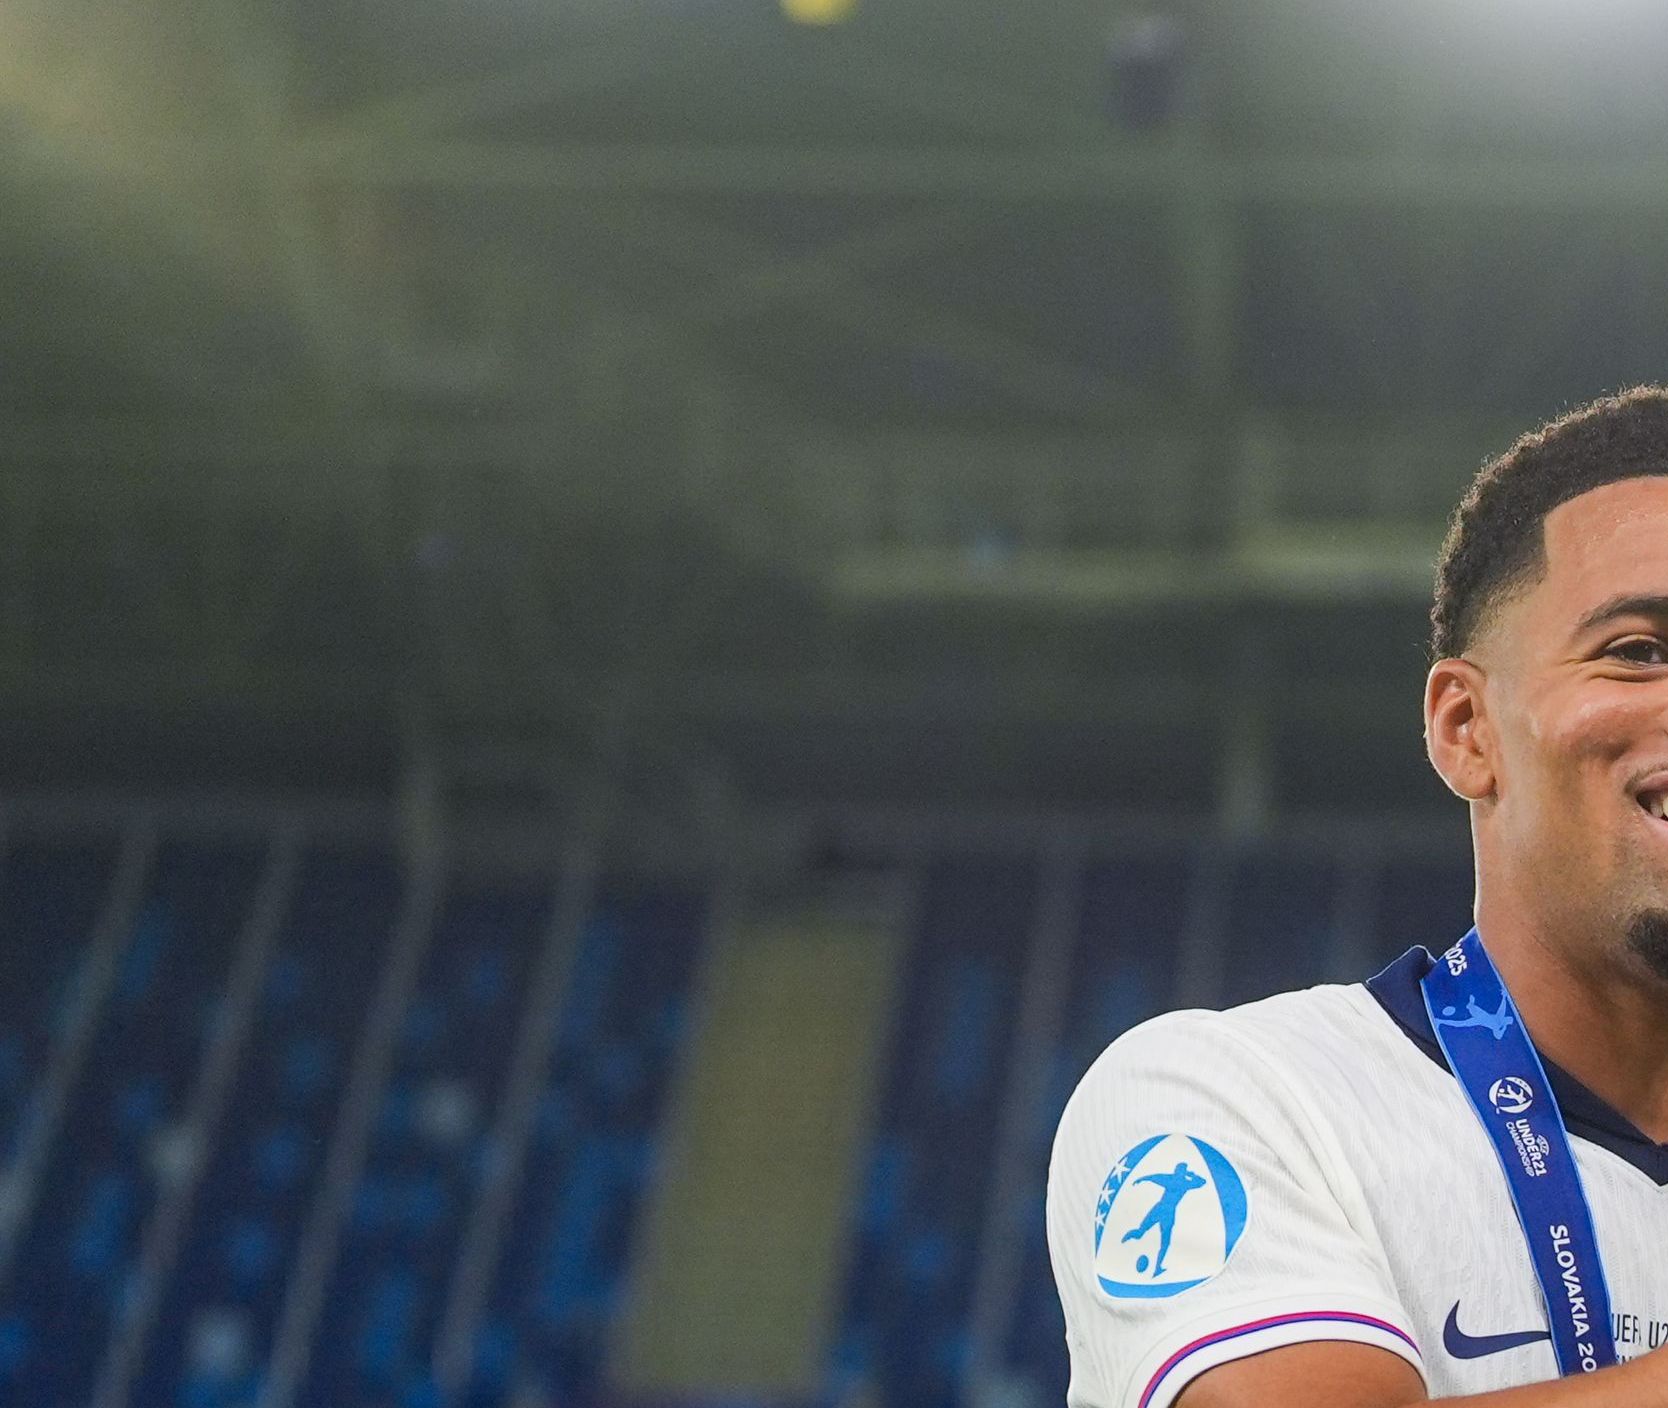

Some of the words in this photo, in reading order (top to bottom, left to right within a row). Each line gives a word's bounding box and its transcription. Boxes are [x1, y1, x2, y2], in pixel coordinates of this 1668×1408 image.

[1505, 1121, 1535, 1178] CHAMPIONSHIP
[1515, 1118, 1547, 1177] UNDER21
[1549, 1224, 1590, 1338] SLOVAKIA
[1577, 1342, 1598, 1373] 20
